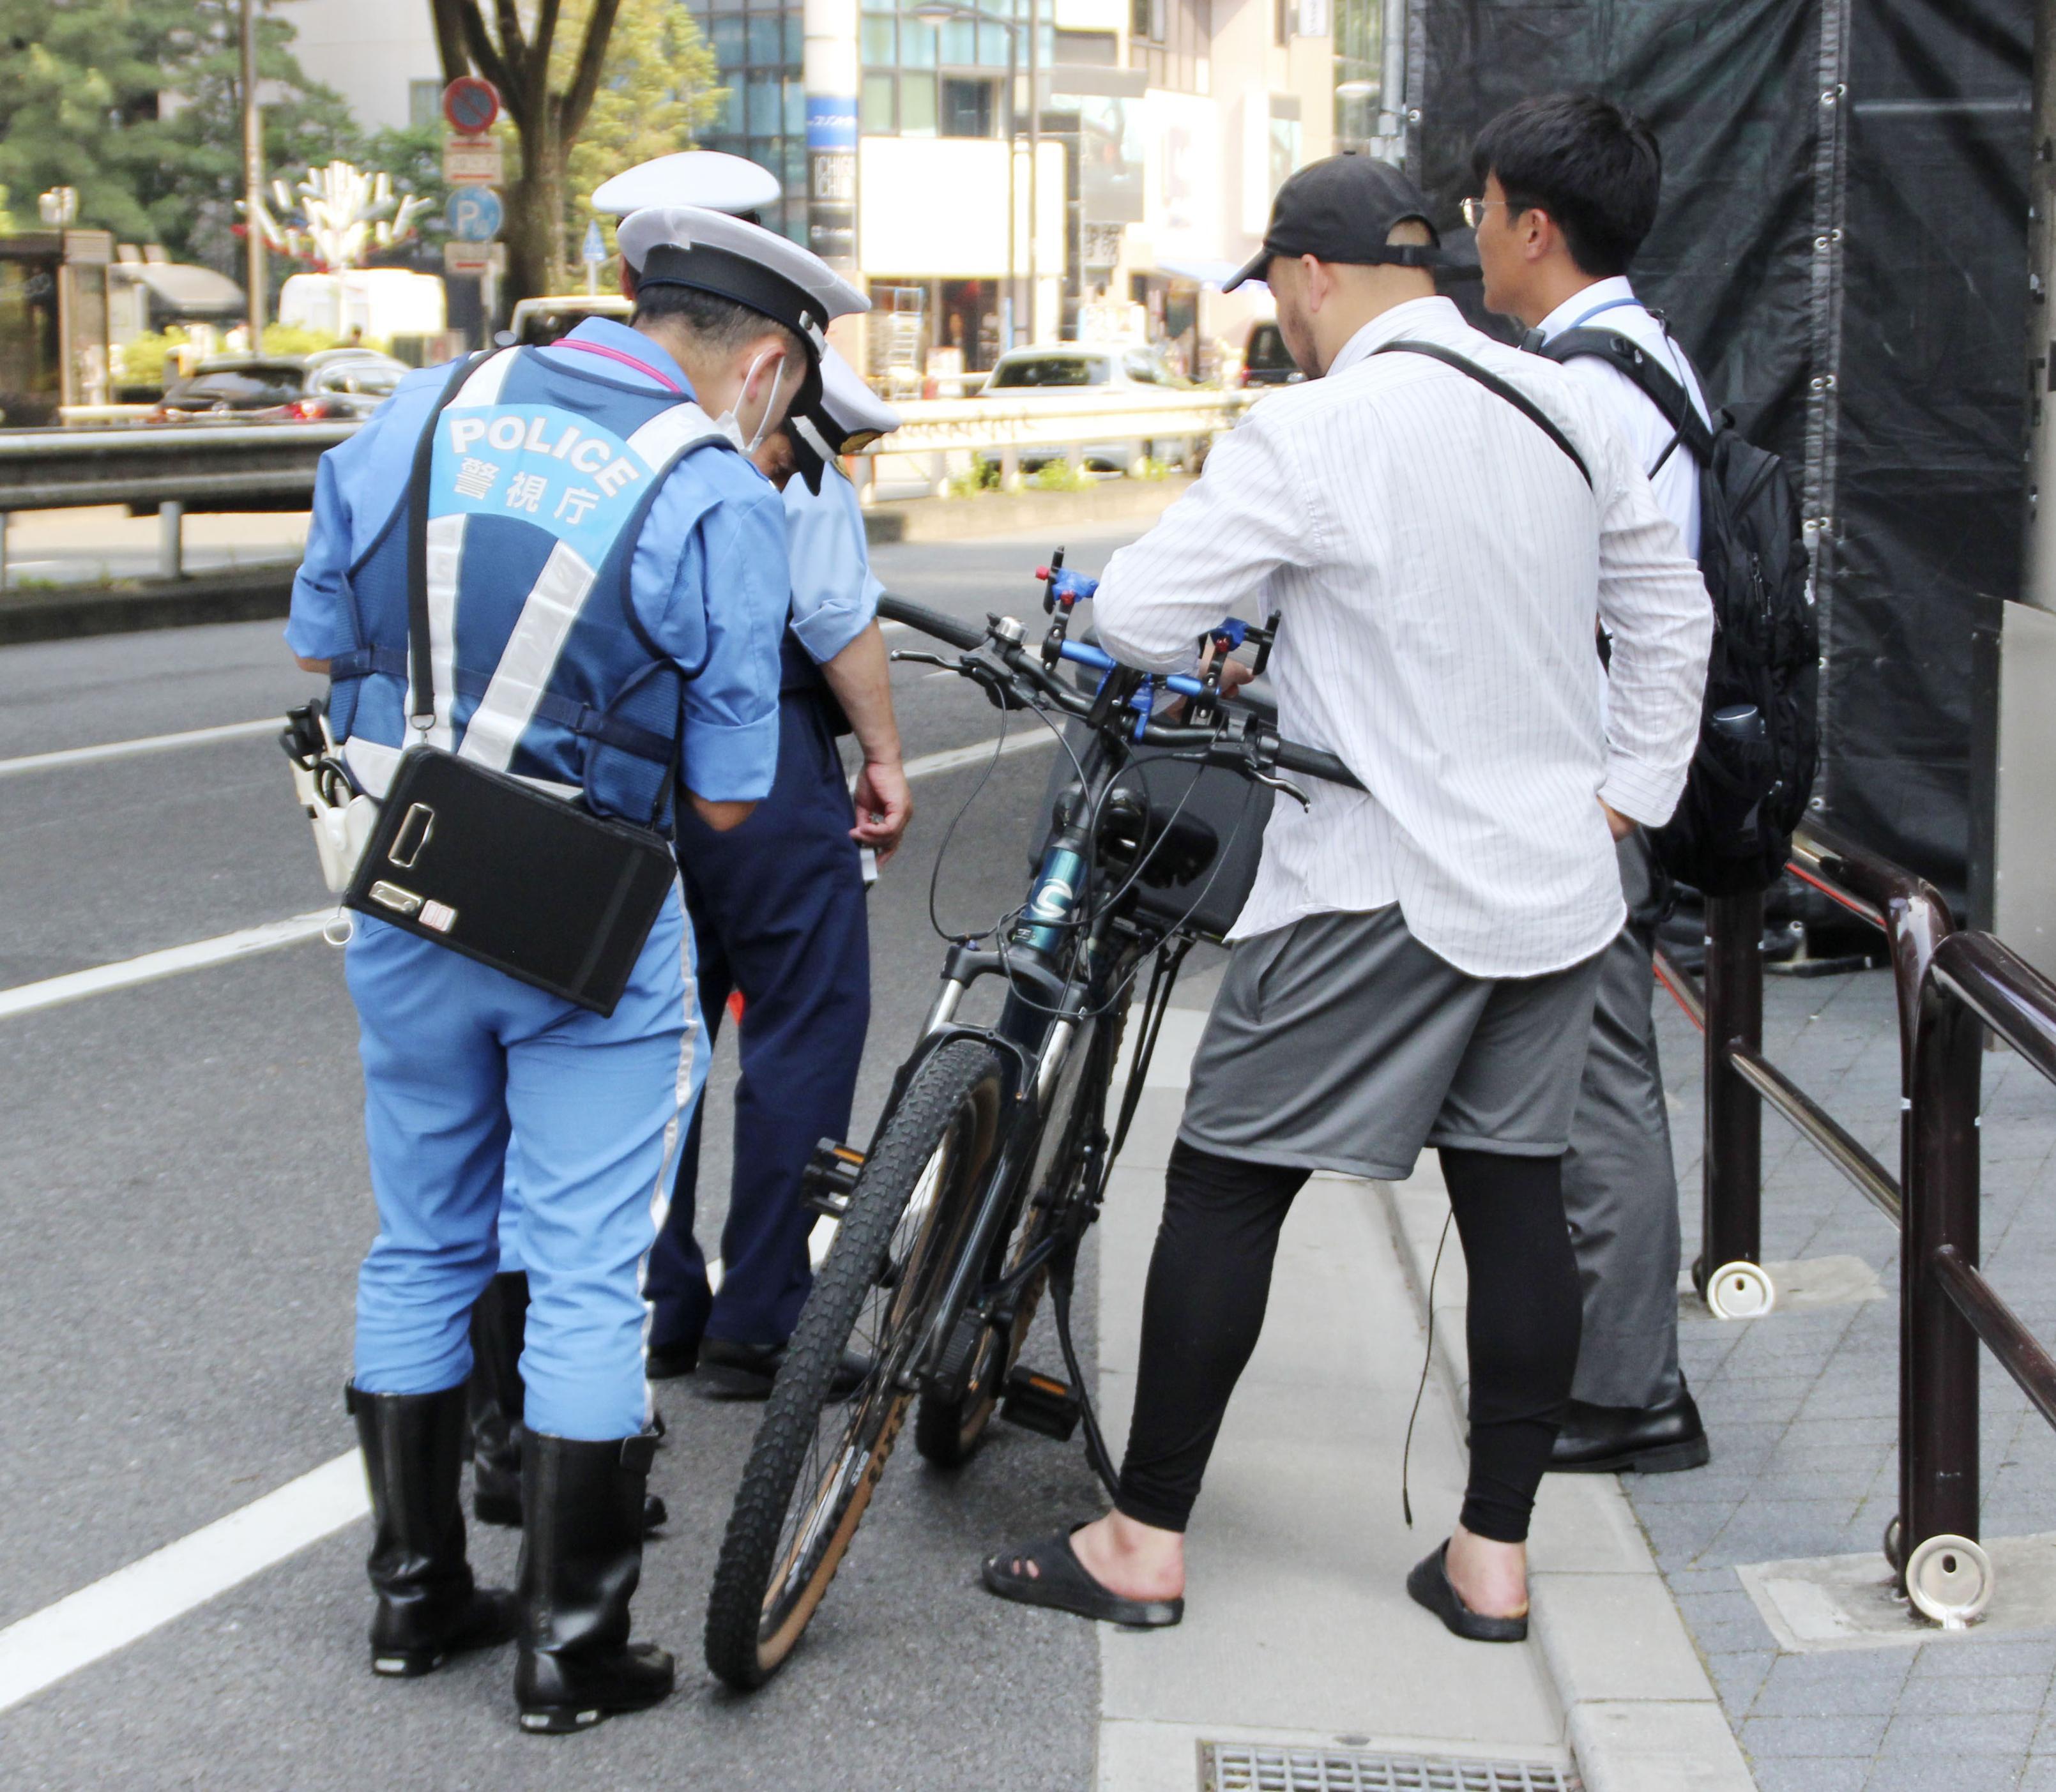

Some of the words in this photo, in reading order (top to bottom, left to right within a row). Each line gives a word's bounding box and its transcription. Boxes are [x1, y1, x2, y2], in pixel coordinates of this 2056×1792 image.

[457, 200, 479, 236] P
[450, 416, 640, 497] POLICE
[453, 457, 600, 525] 警視庁
